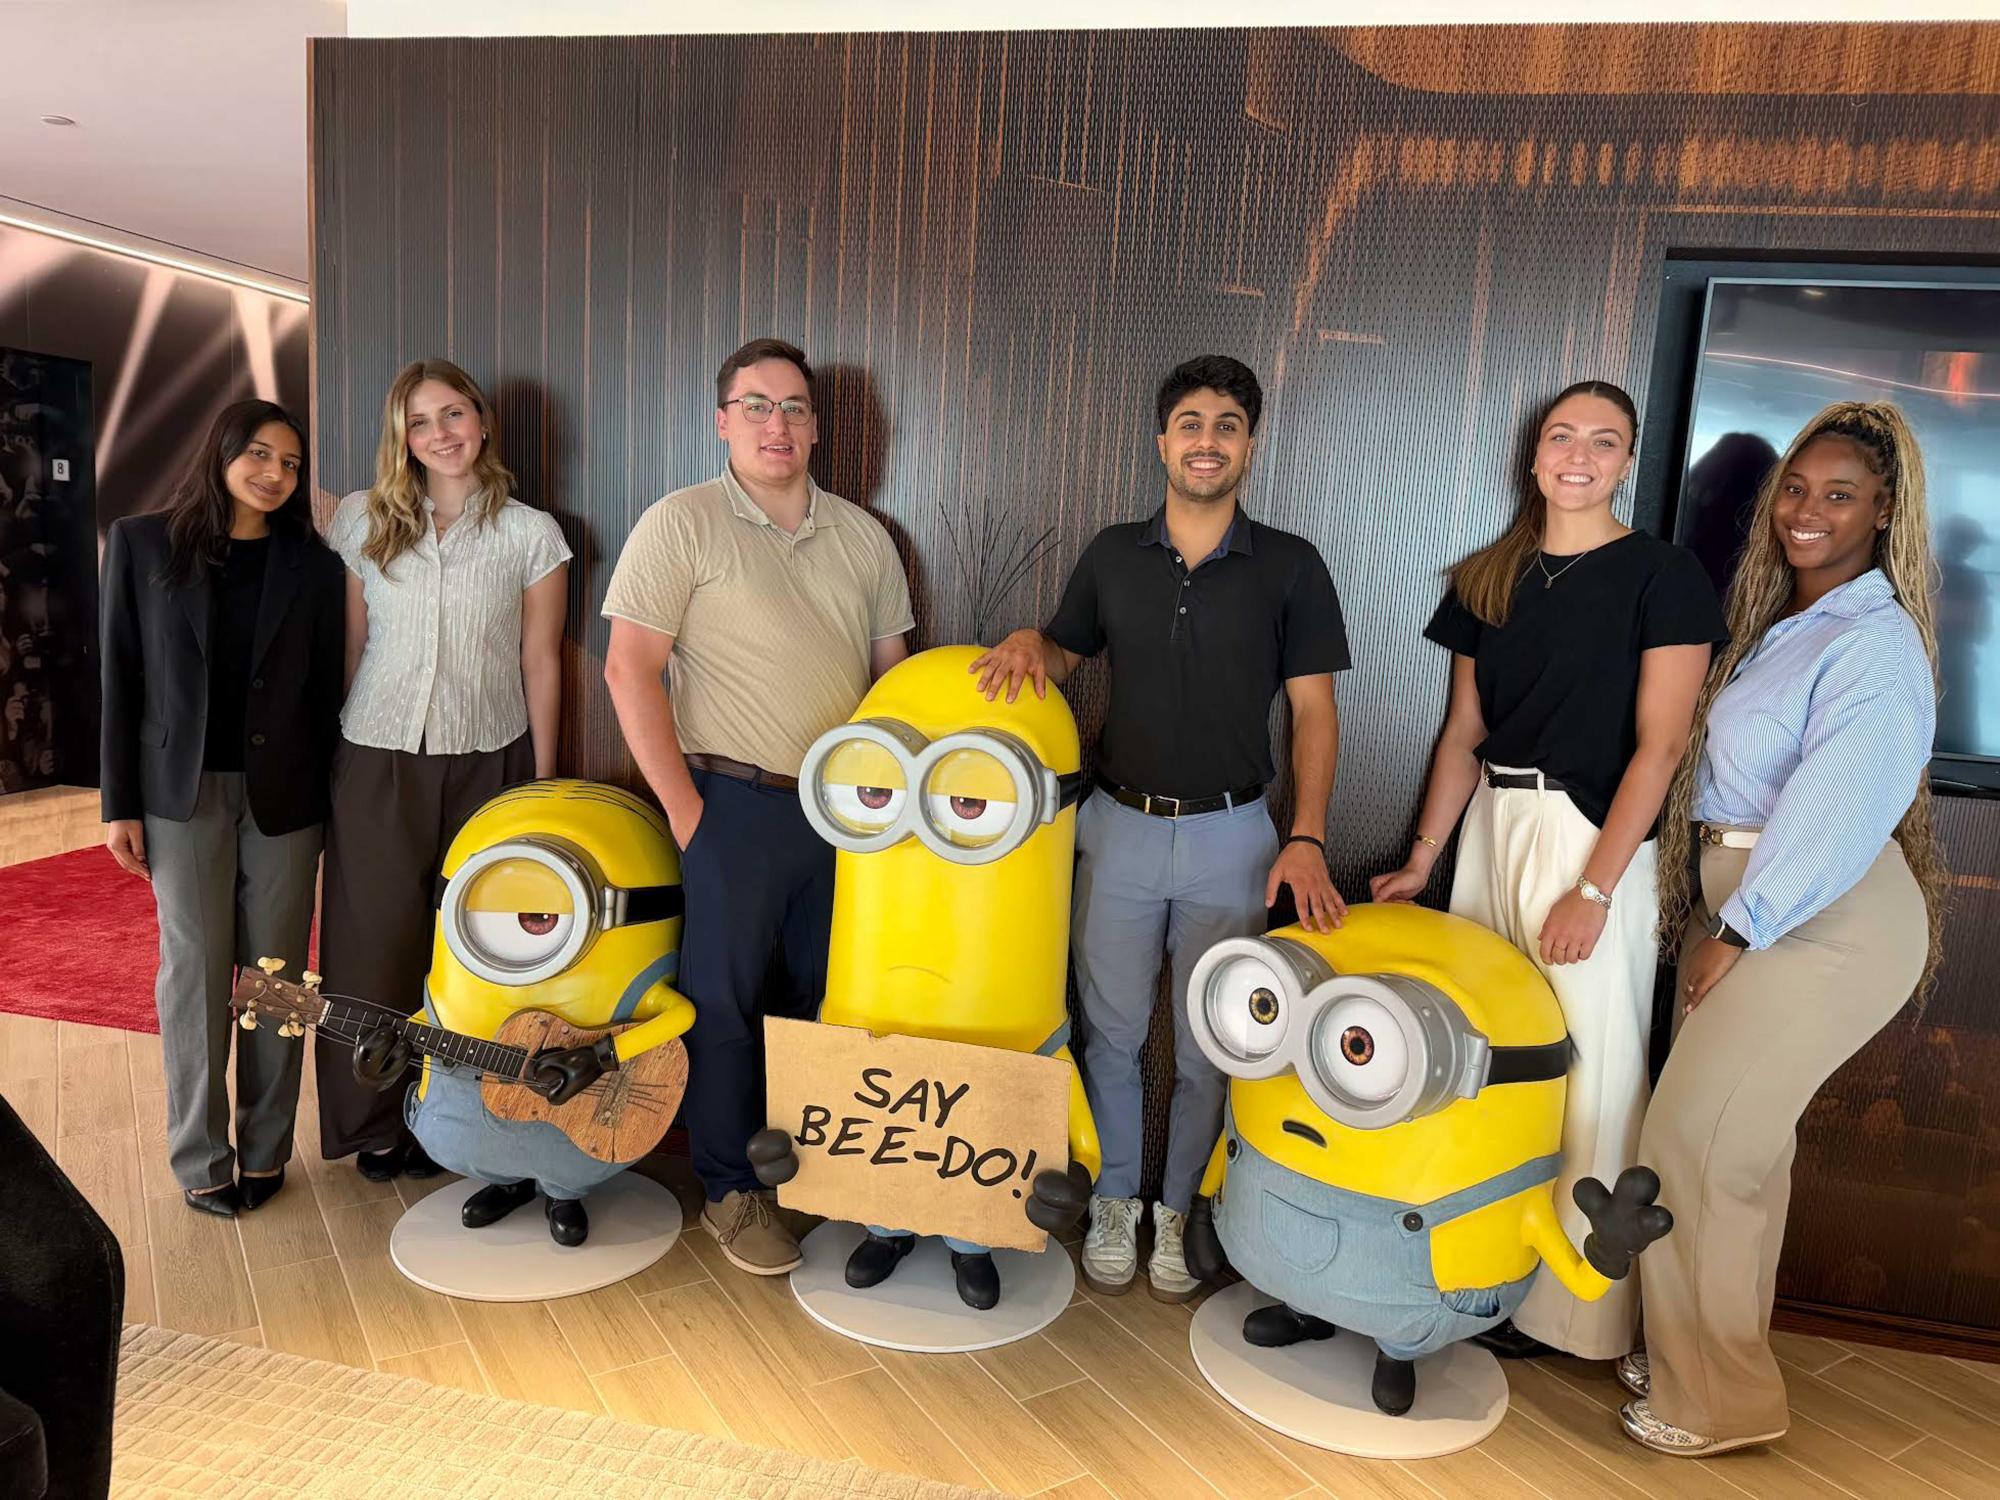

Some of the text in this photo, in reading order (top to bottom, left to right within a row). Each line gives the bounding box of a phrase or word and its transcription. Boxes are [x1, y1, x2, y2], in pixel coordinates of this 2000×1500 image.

[57, 462, 64, 475] 8
[854, 1068, 970, 1129] SAY
[794, 1104, 1037, 1199] BEE-DO!
